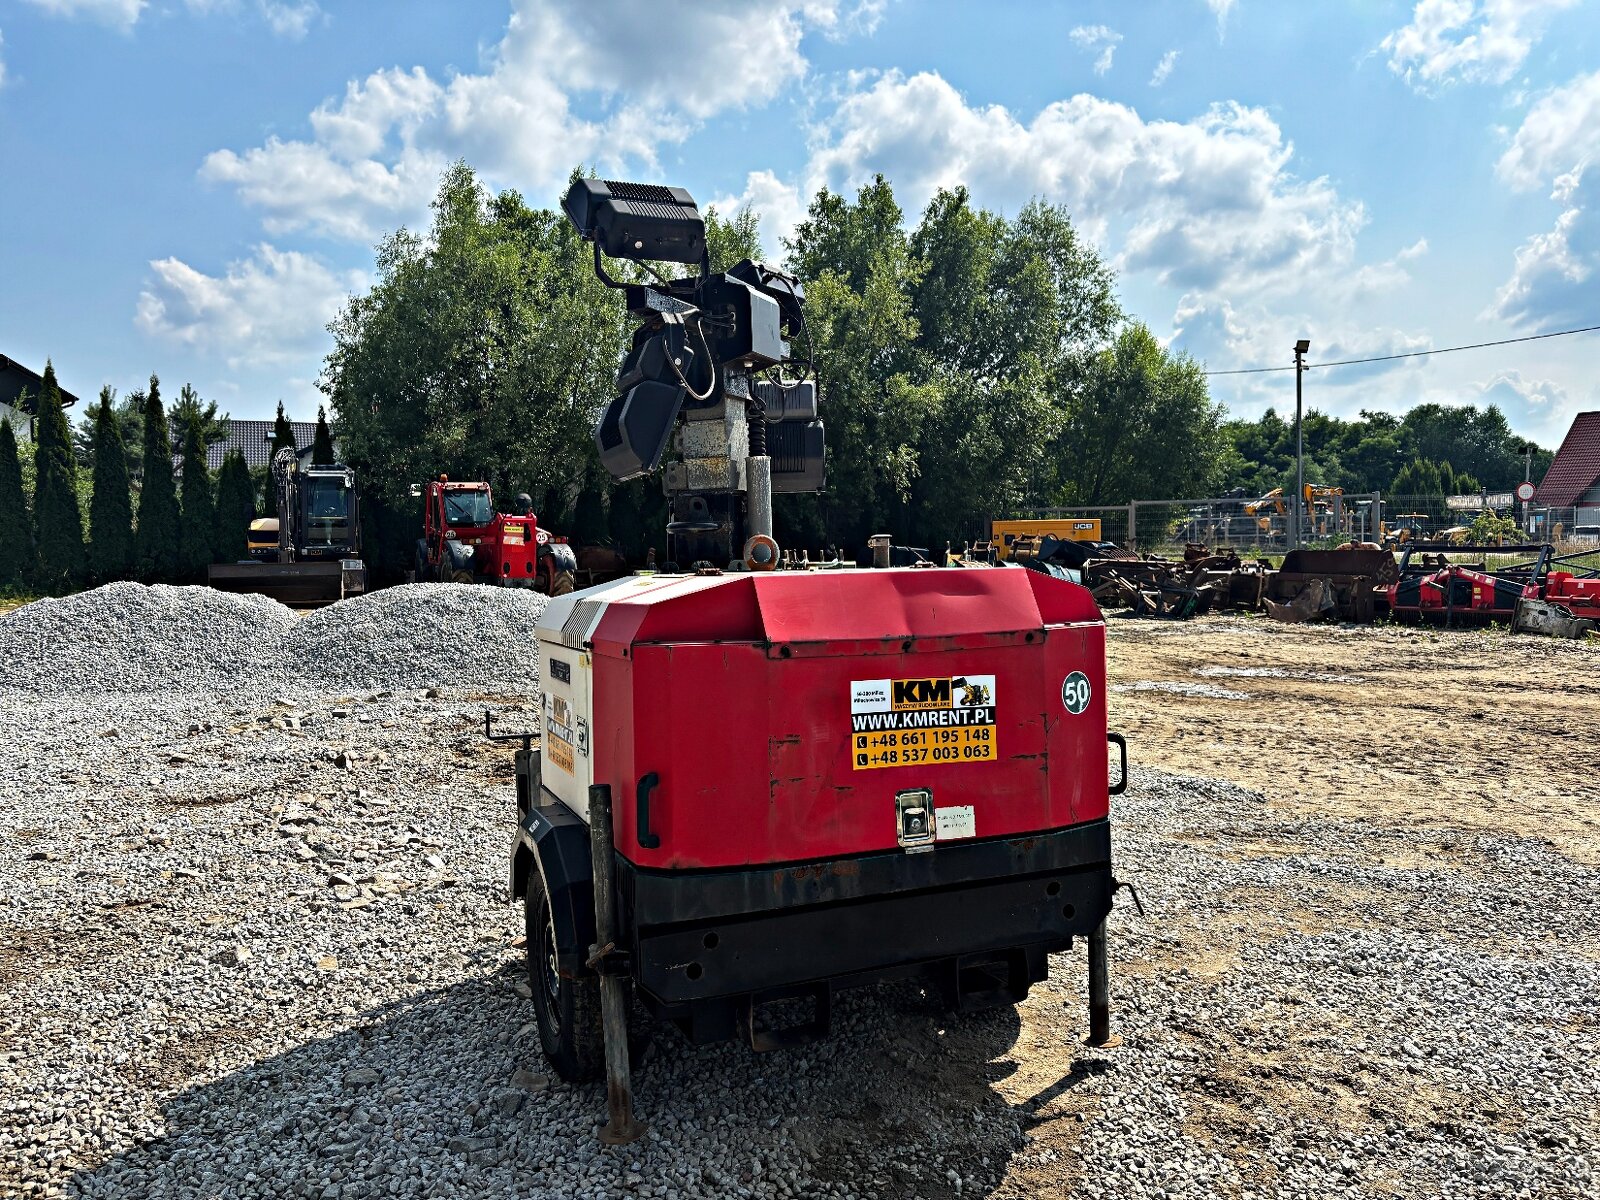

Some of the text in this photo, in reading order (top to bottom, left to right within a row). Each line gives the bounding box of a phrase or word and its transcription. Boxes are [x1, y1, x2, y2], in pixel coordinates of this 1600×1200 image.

[893, 680, 950, 703] KM
[1064, 679, 1089, 706] 50
[852, 708, 993, 731] WWW.KMRENT.PL
[870, 729, 990, 747] +48 661 195 148
[870, 745, 990, 764] +48 537 003 063
